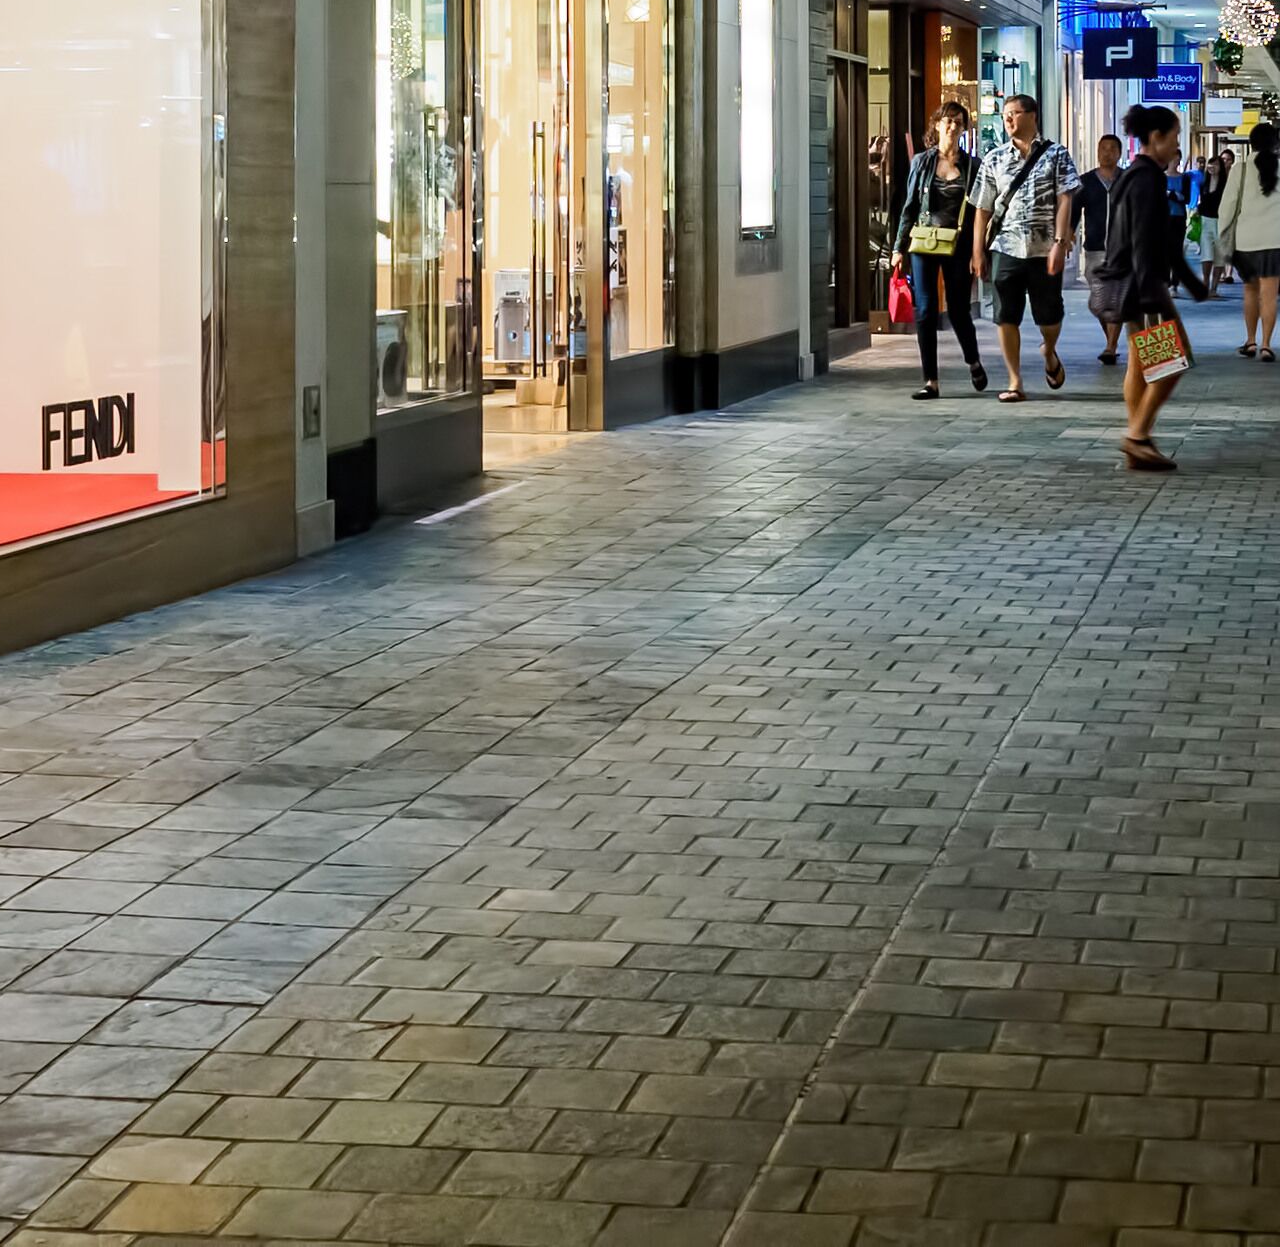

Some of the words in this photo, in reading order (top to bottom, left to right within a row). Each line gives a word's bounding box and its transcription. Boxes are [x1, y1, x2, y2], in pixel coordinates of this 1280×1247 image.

[1159, 83, 1185, 92] Works
[1175, 75, 1196, 84] Body
[1135, 323, 1176, 349] BATH
[1140, 346, 1181, 366] WORKS
[41, 392, 135, 471] FENDI
